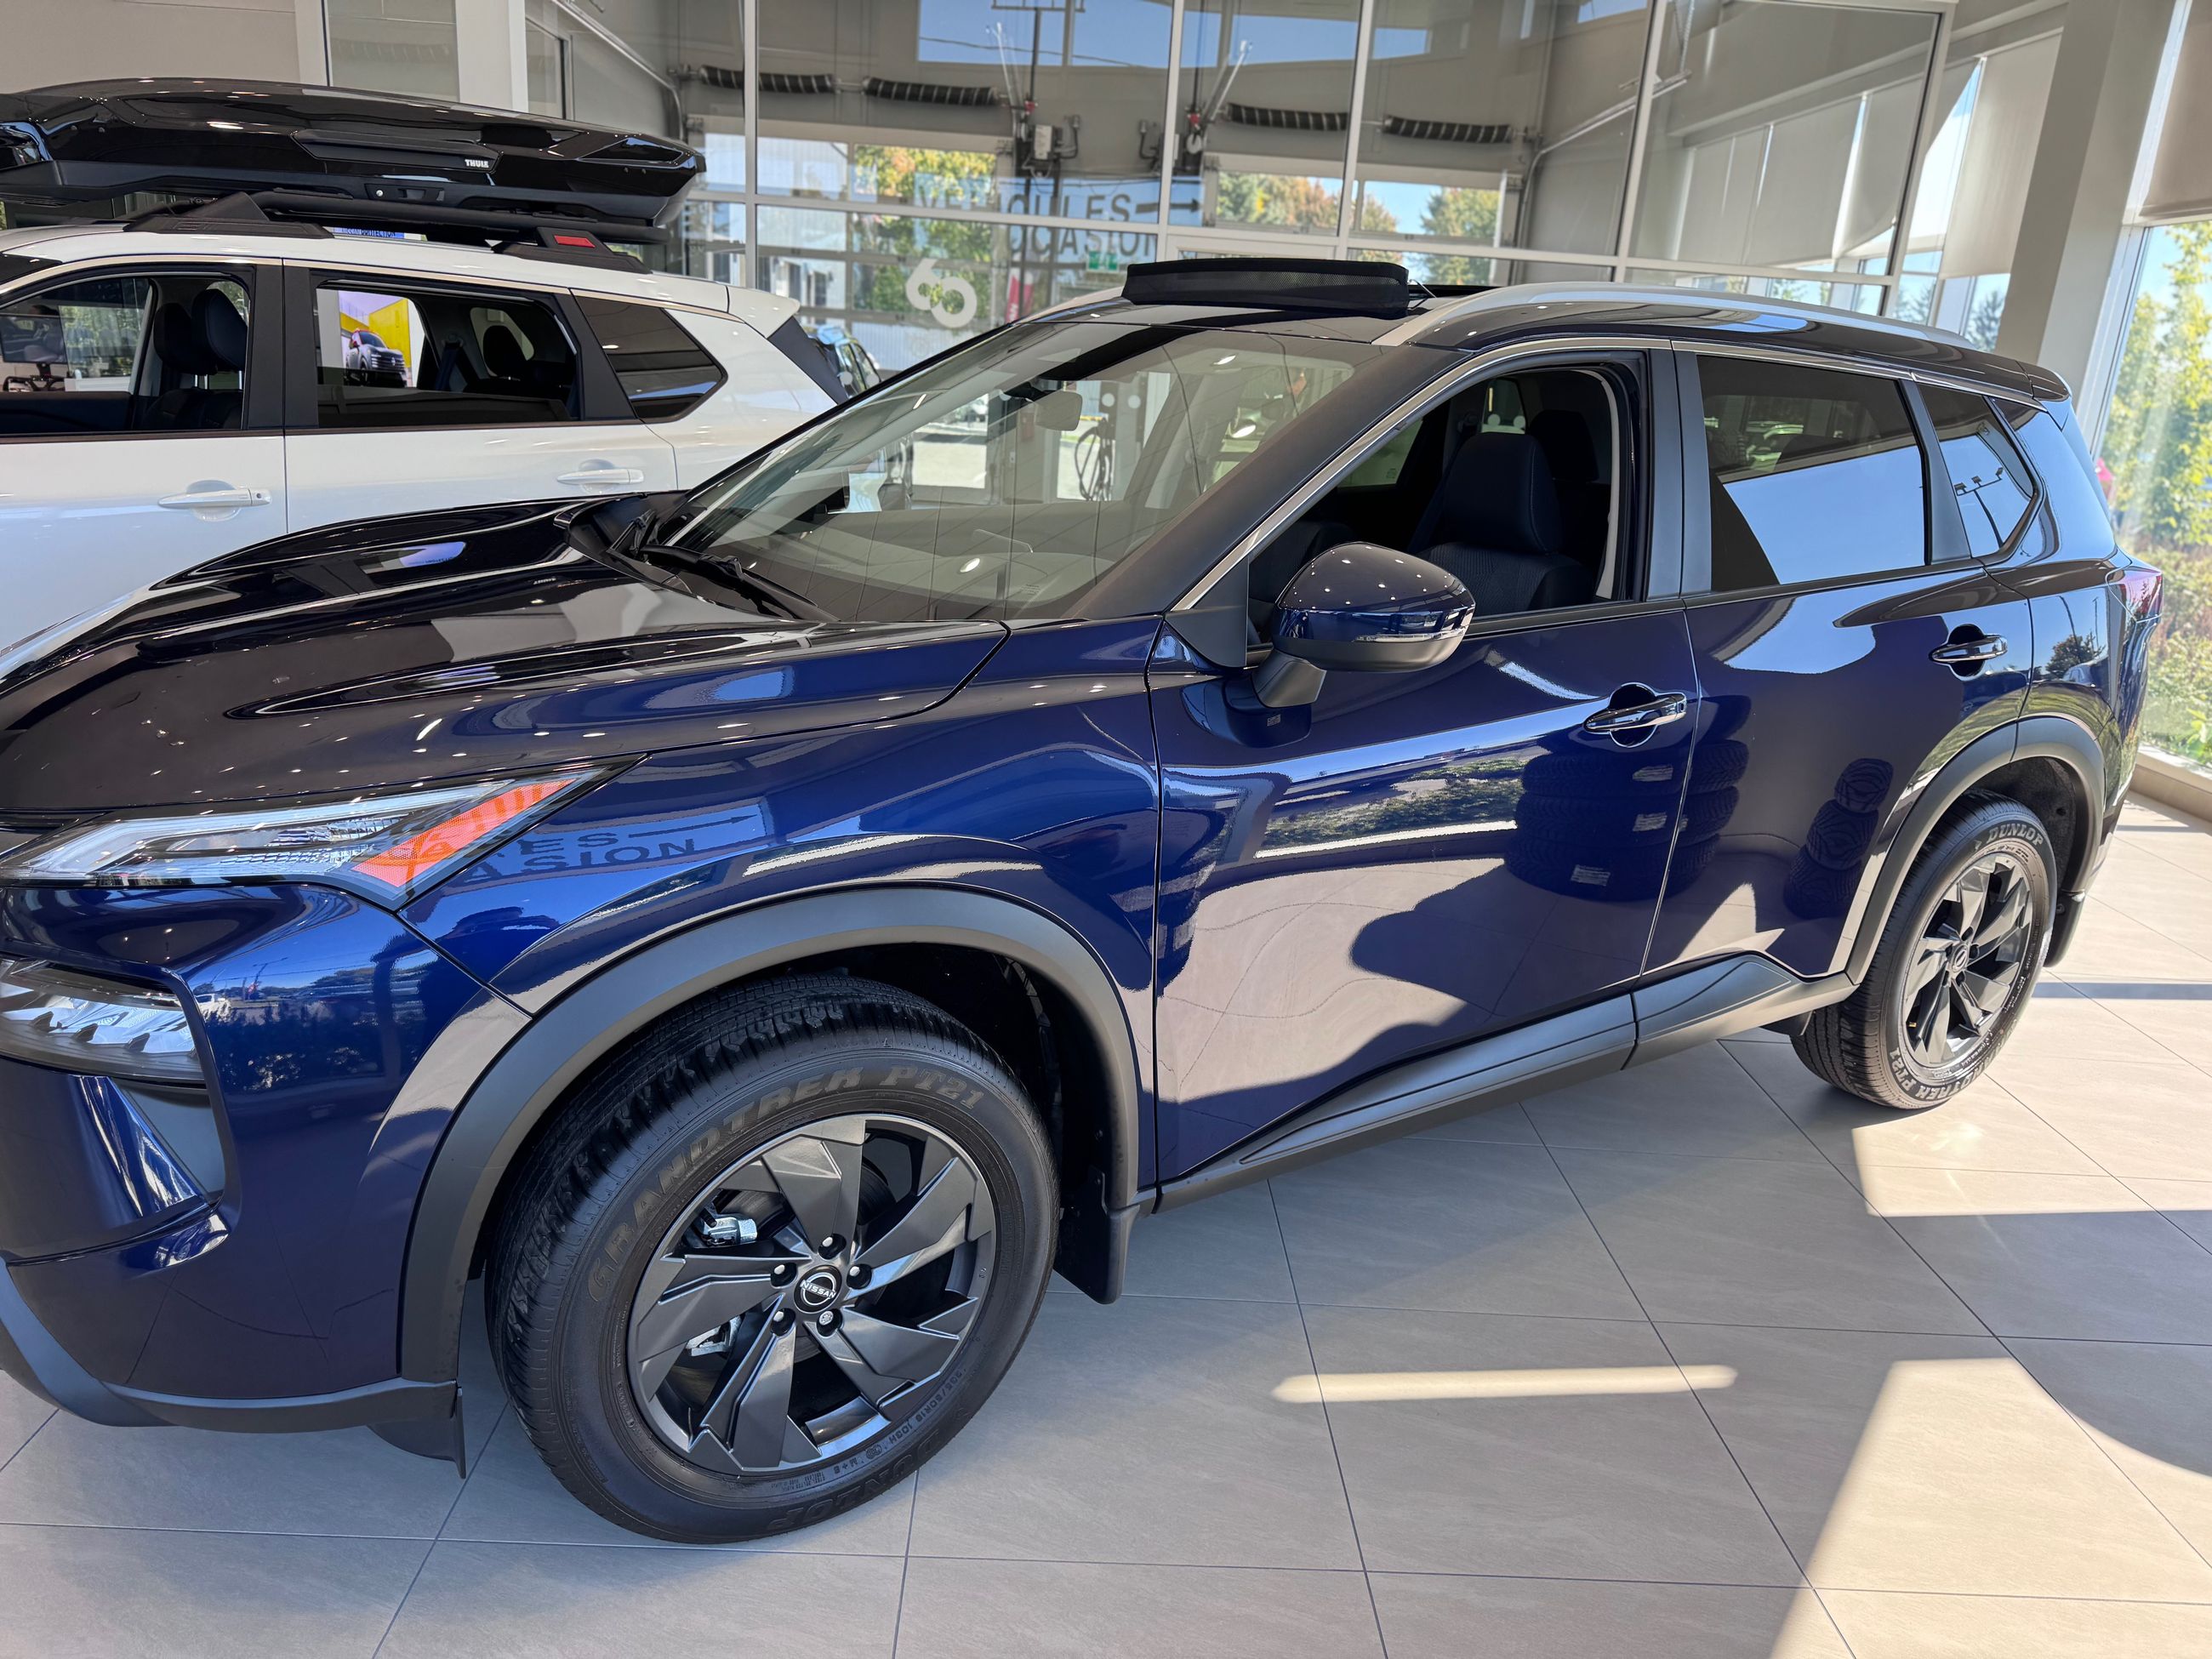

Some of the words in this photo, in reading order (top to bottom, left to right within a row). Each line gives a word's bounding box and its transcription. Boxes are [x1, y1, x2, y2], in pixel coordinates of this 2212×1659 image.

[465, 158, 489, 168] THULE
[1986, 823, 2044, 846] DUNLOP
[587, 1065, 864, 1302] GRANDTREK
[879, 1065, 984, 1110] PT21
[800, 1279, 838, 1299] NISSAN
[767, 1428, 942, 1530] DUNLOP
